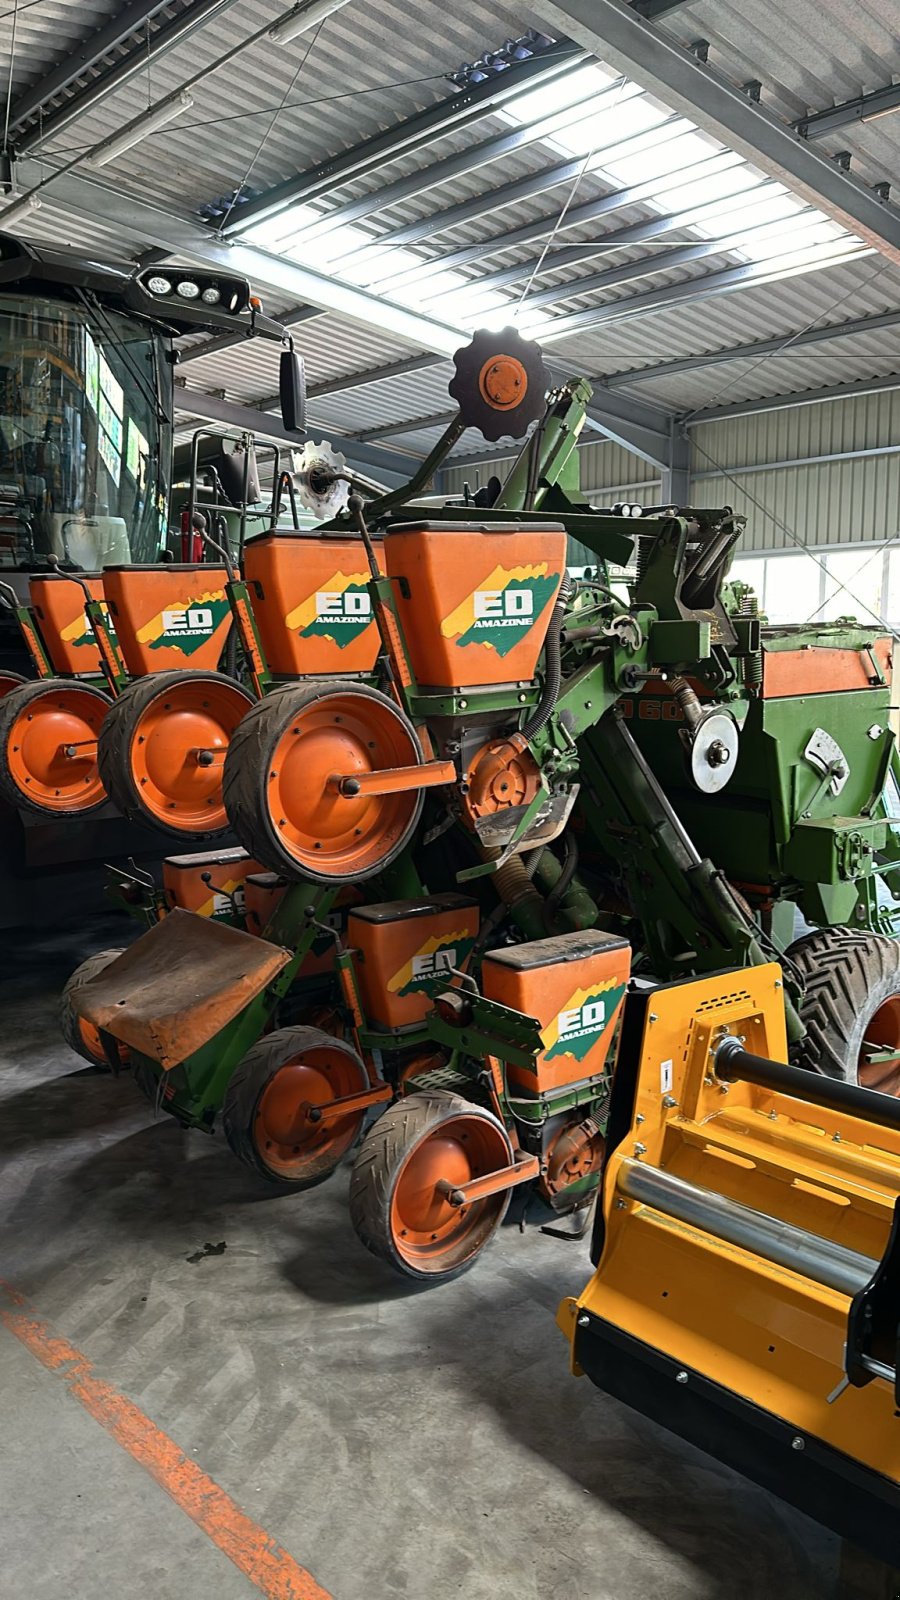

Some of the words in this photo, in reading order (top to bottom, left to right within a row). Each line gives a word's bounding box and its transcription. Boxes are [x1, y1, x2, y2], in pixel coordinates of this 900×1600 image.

[316, 592, 370, 614] ED
[476, 589, 533, 617] ED
[162, 608, 212, 629] ED
[474, 617, 533, 628] AMAZONE
[163, 628, 213, 637] AMAZONE
[412, 949, 456, 976] ED
[411, 969, 450, 982] AMAZON
[558, 1000, 605, 1037] ED
[557, 1023, 606, 1043] AMAZONE
